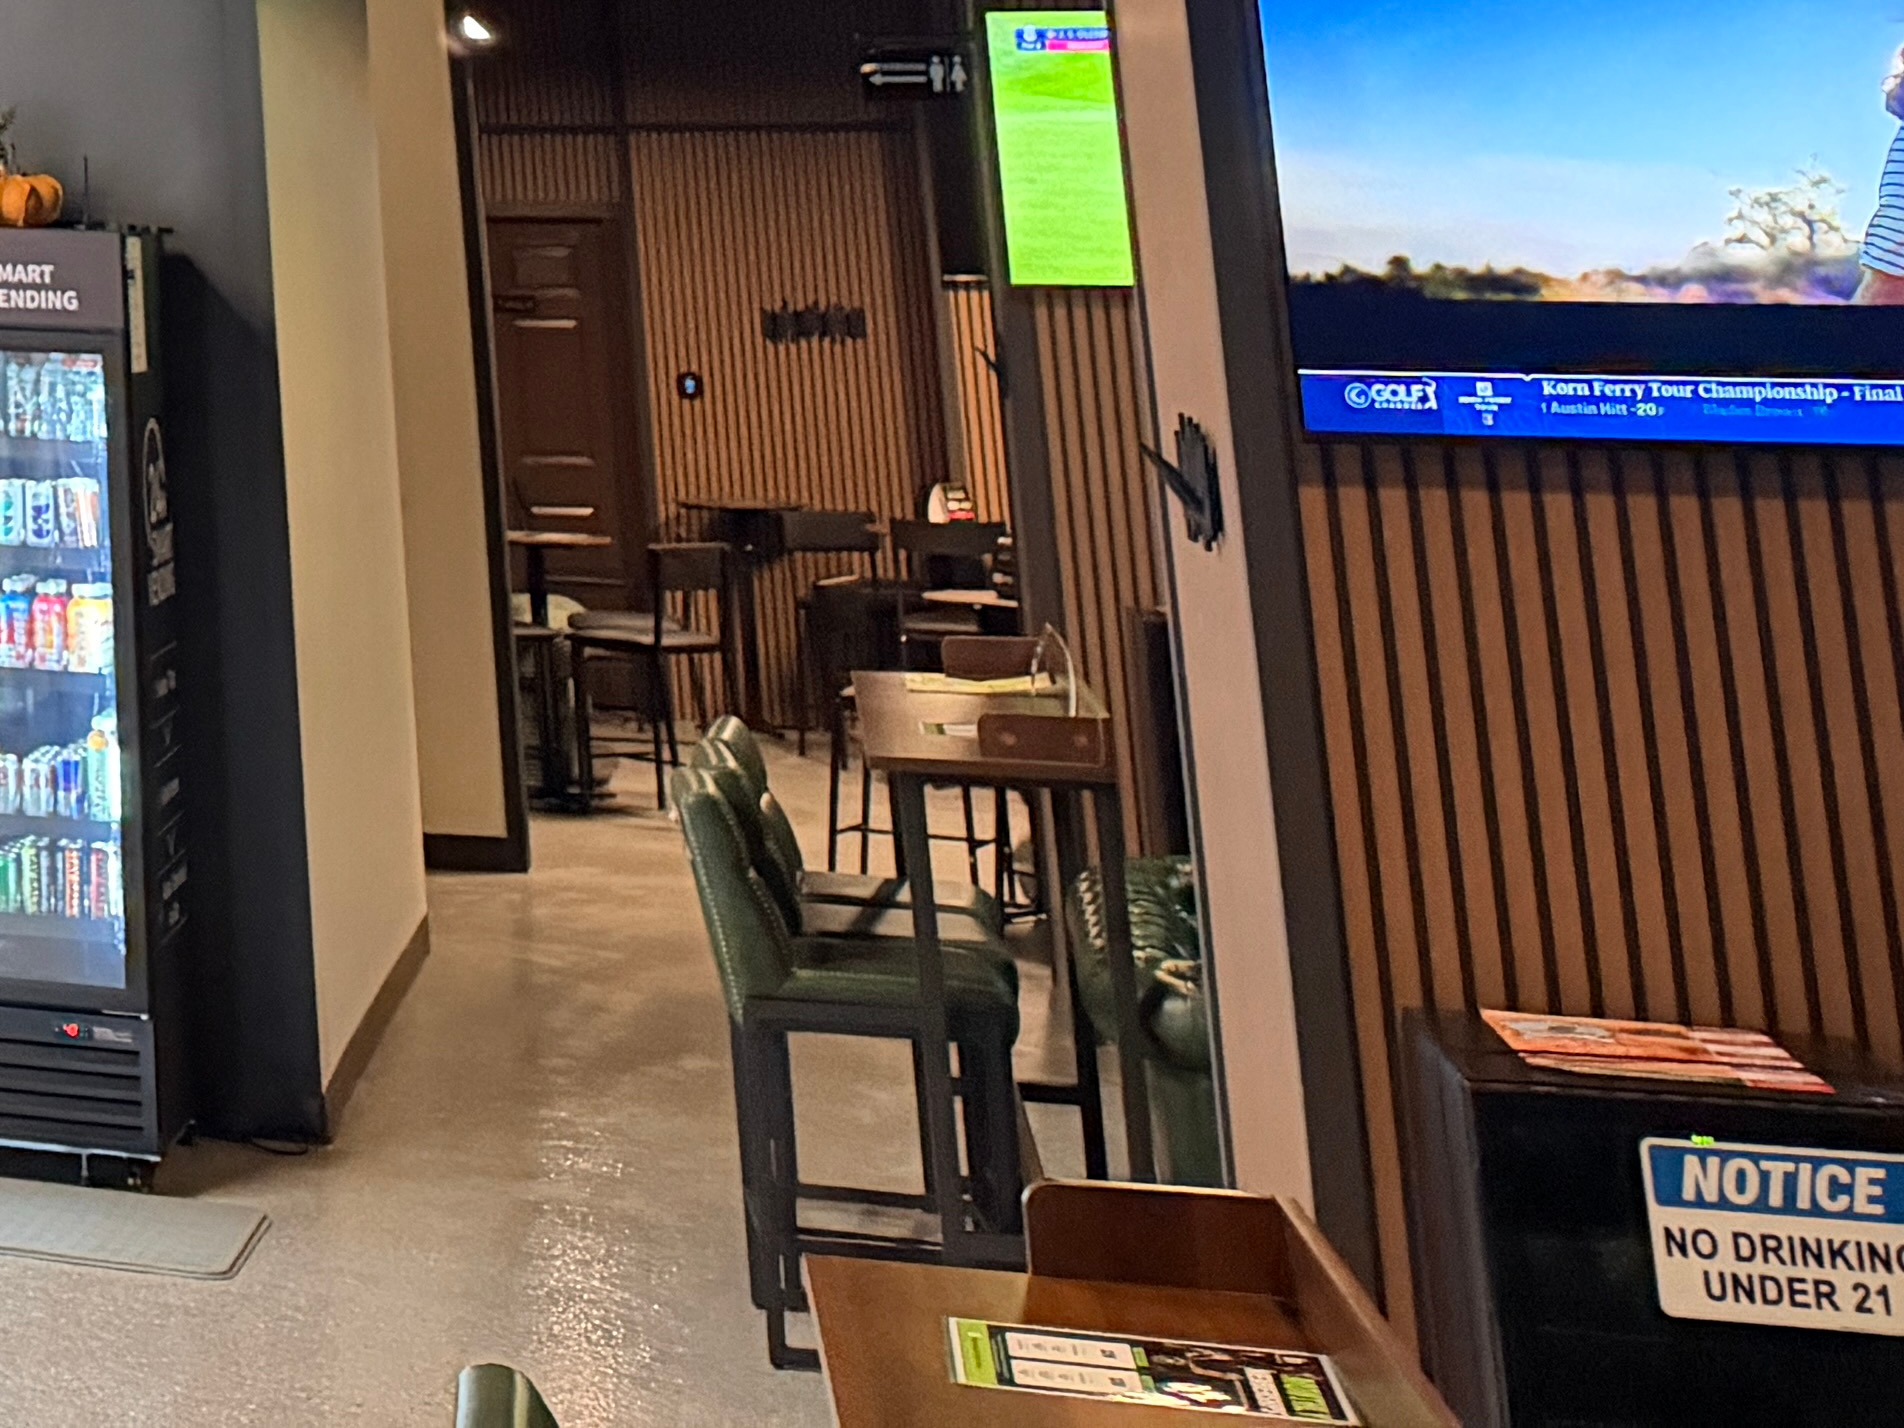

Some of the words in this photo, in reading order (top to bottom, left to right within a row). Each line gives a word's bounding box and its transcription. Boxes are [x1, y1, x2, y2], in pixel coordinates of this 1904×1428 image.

[1370, 384, 1425, 401] GOLF
[1542, 381, 1590, 395] Korn
[1593, 381, 1645, 400] Ferry
[1648, 382, 1695, 398] Tour
[1698, 382, 1838, 404] Championship
[1853, 386, 1903, 401] Final
[1551, 401, 1598, 415] Austin
[1682, 1154, 1887, 1215] NOTICE
[1663, 1226, 1719, 1260] NO
[1703, 1270, 1841, 1312] UNDER
[1852, 1282, 1892, 1316] 21
